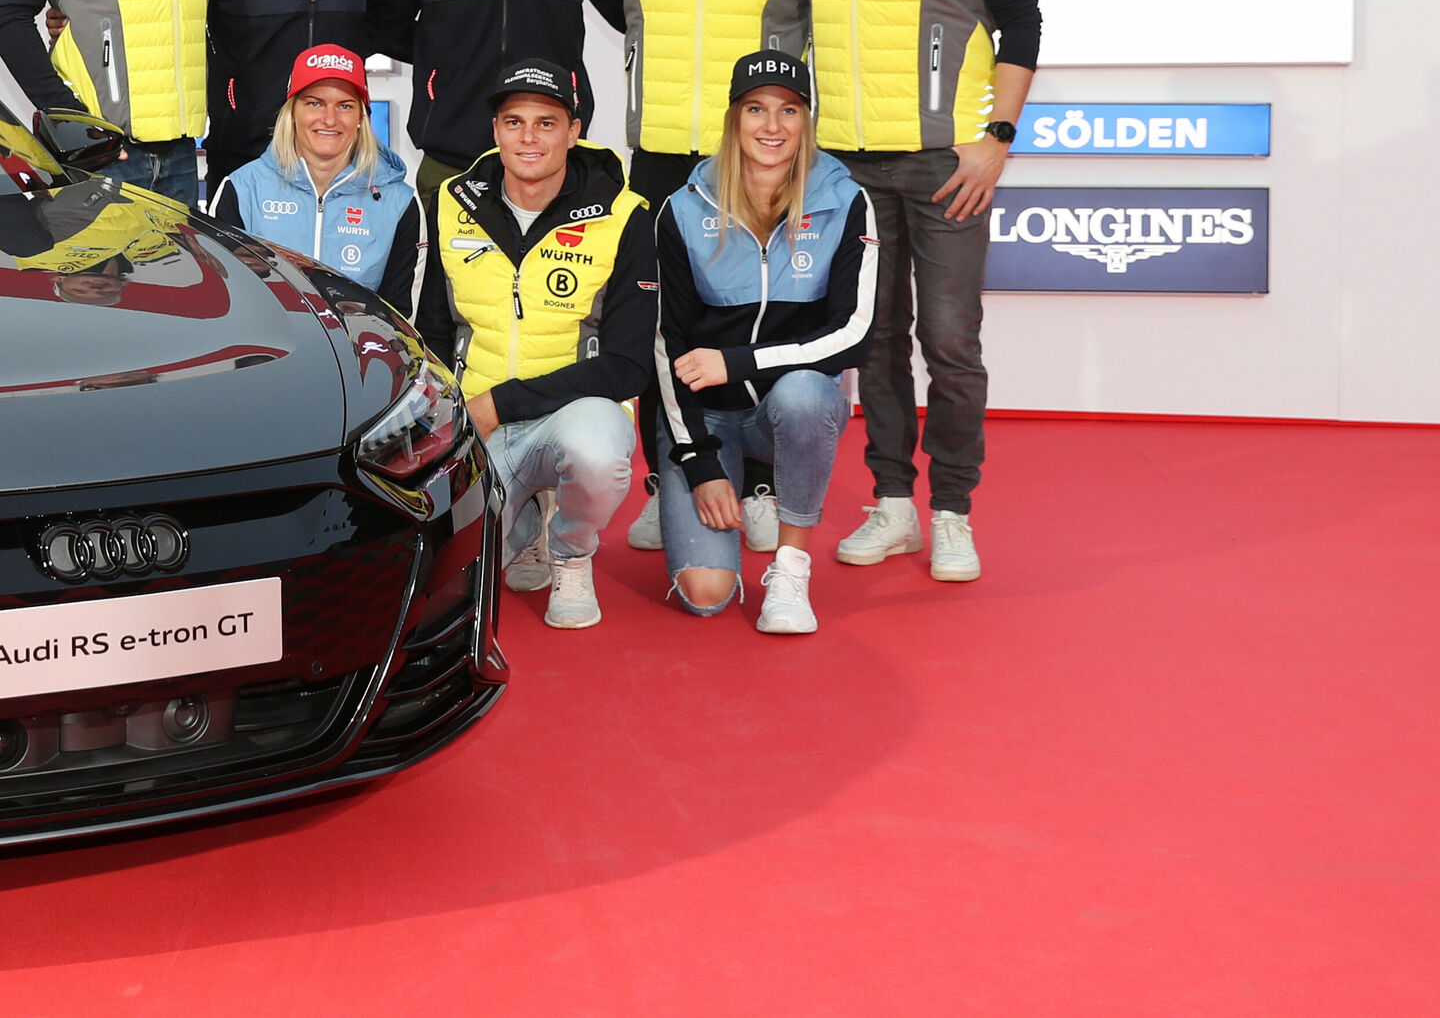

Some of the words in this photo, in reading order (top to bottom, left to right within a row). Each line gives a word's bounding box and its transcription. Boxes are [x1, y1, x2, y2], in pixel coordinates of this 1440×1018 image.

[748, 60, 796, 78] MBPI
[1032, 110, 1208, 149] SÖLDEN
[990, 207, 1254, 244] LONGINES
[540, 247, 593, 265] WÜRTH
[544, 299, 576, 309] BOGNER
[71, 632, 110, 657] RS
[120, 624, 208, 651] e-tron
[217, 611, 255, 637] GT
